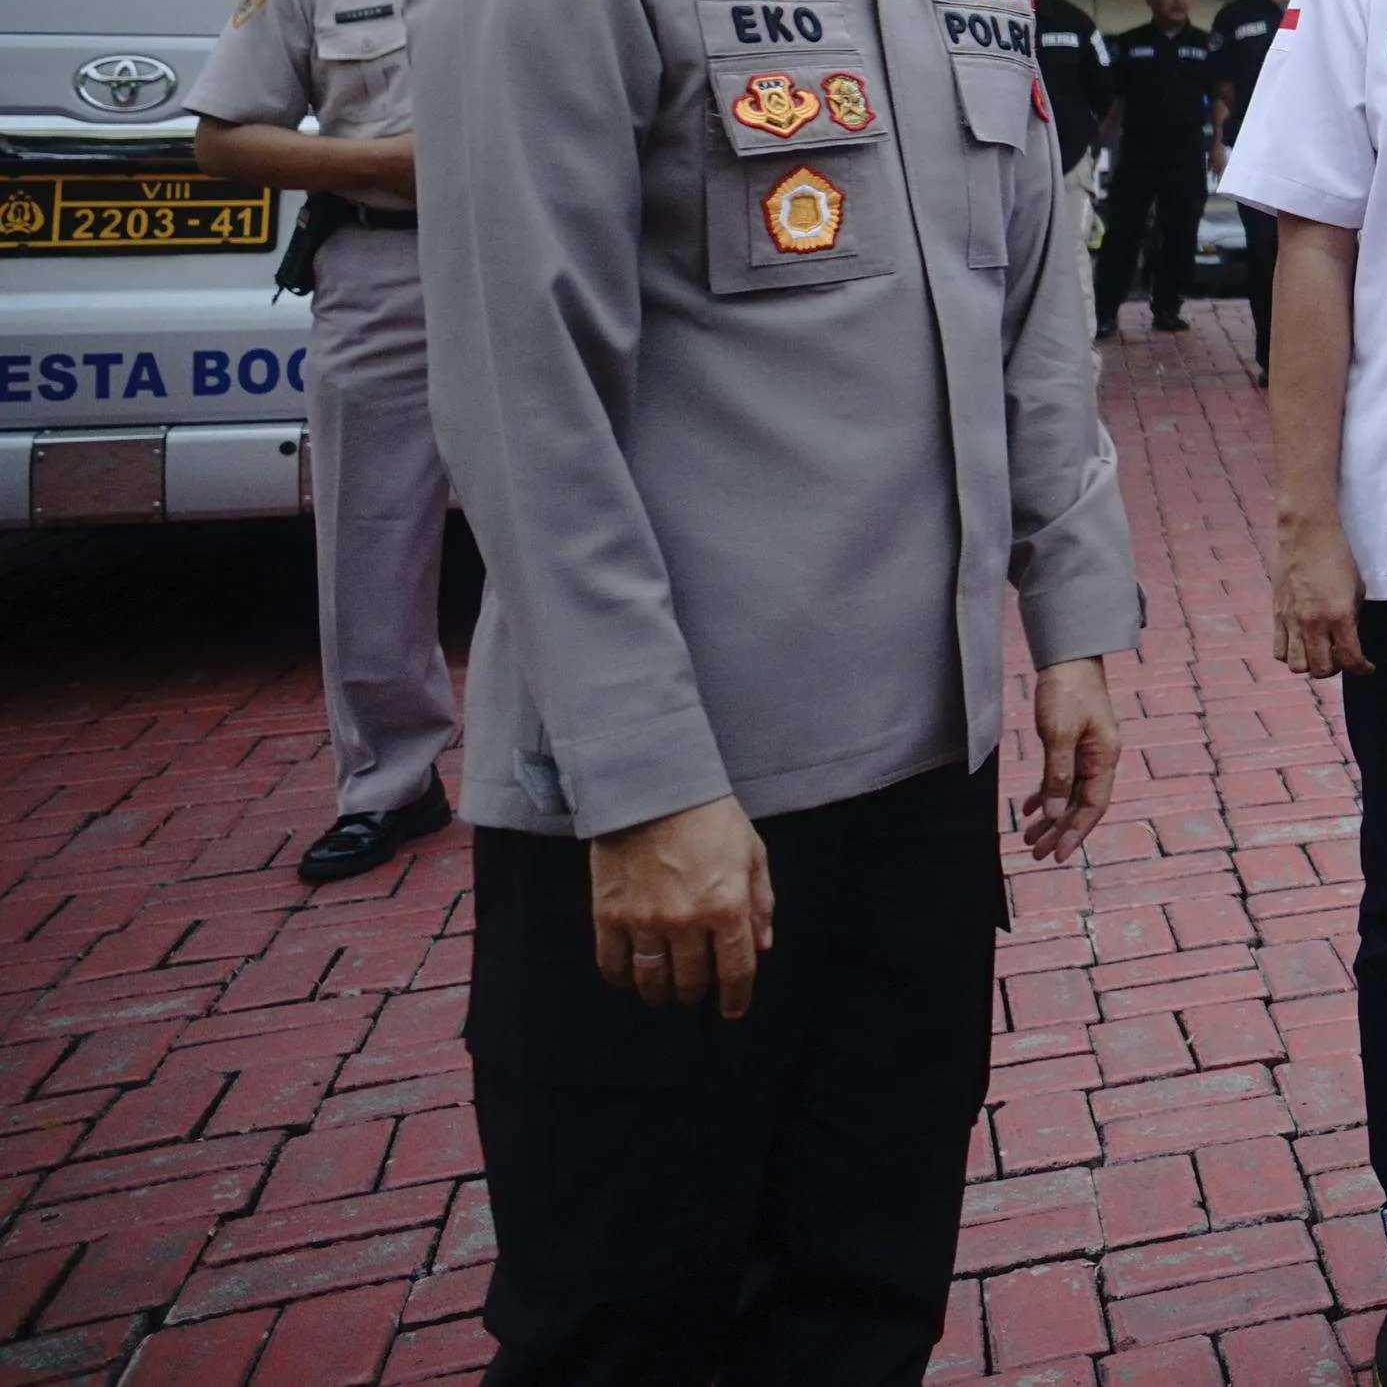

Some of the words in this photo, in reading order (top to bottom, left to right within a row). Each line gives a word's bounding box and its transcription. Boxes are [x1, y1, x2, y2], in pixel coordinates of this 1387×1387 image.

[730, 4, 824, 45] EKO
[943, 10, 1032, 59] POLRI
[141, 182, 192, 200] VIII
